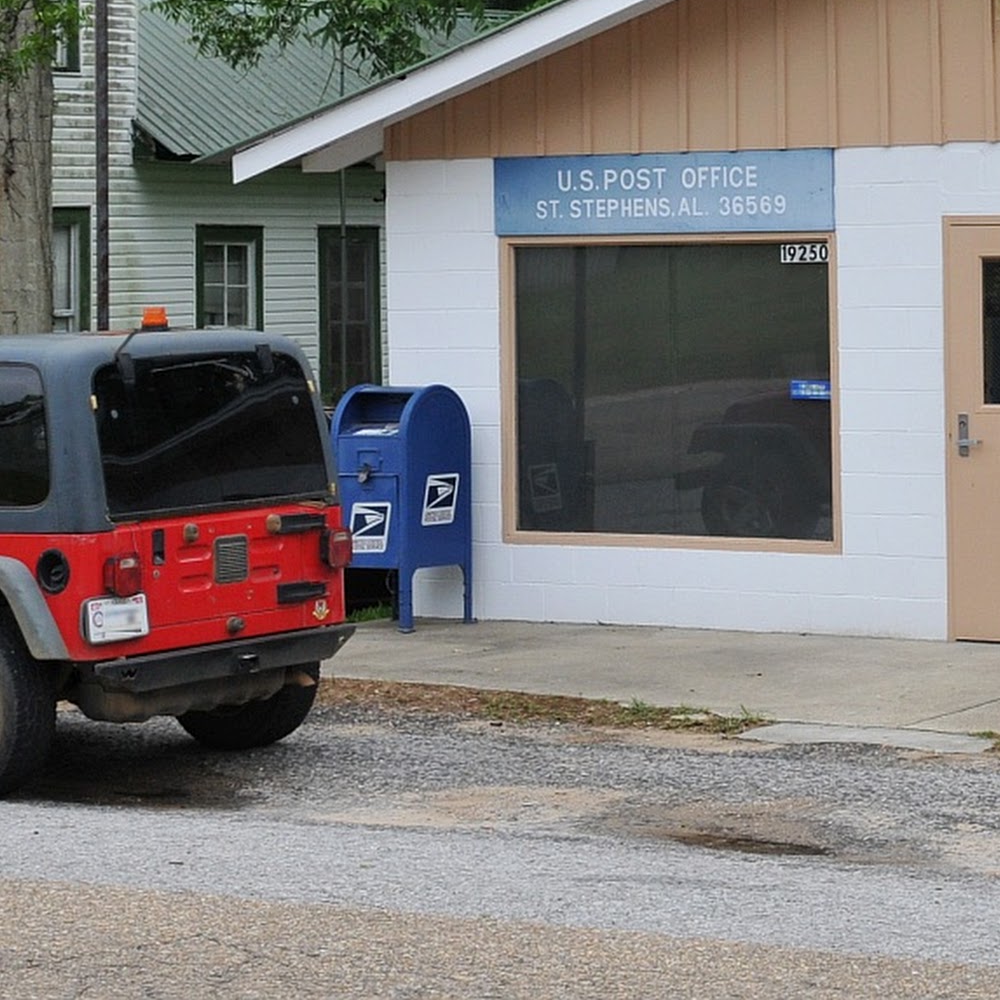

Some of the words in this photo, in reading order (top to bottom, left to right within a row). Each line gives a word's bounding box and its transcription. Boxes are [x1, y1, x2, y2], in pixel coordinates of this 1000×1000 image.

[681, 165, 759, 189] OFFICE
[535, 200, 564, 220] ST.
[718, 193, 787, 217] 36569
[782, 244, 829, 262] 19250
